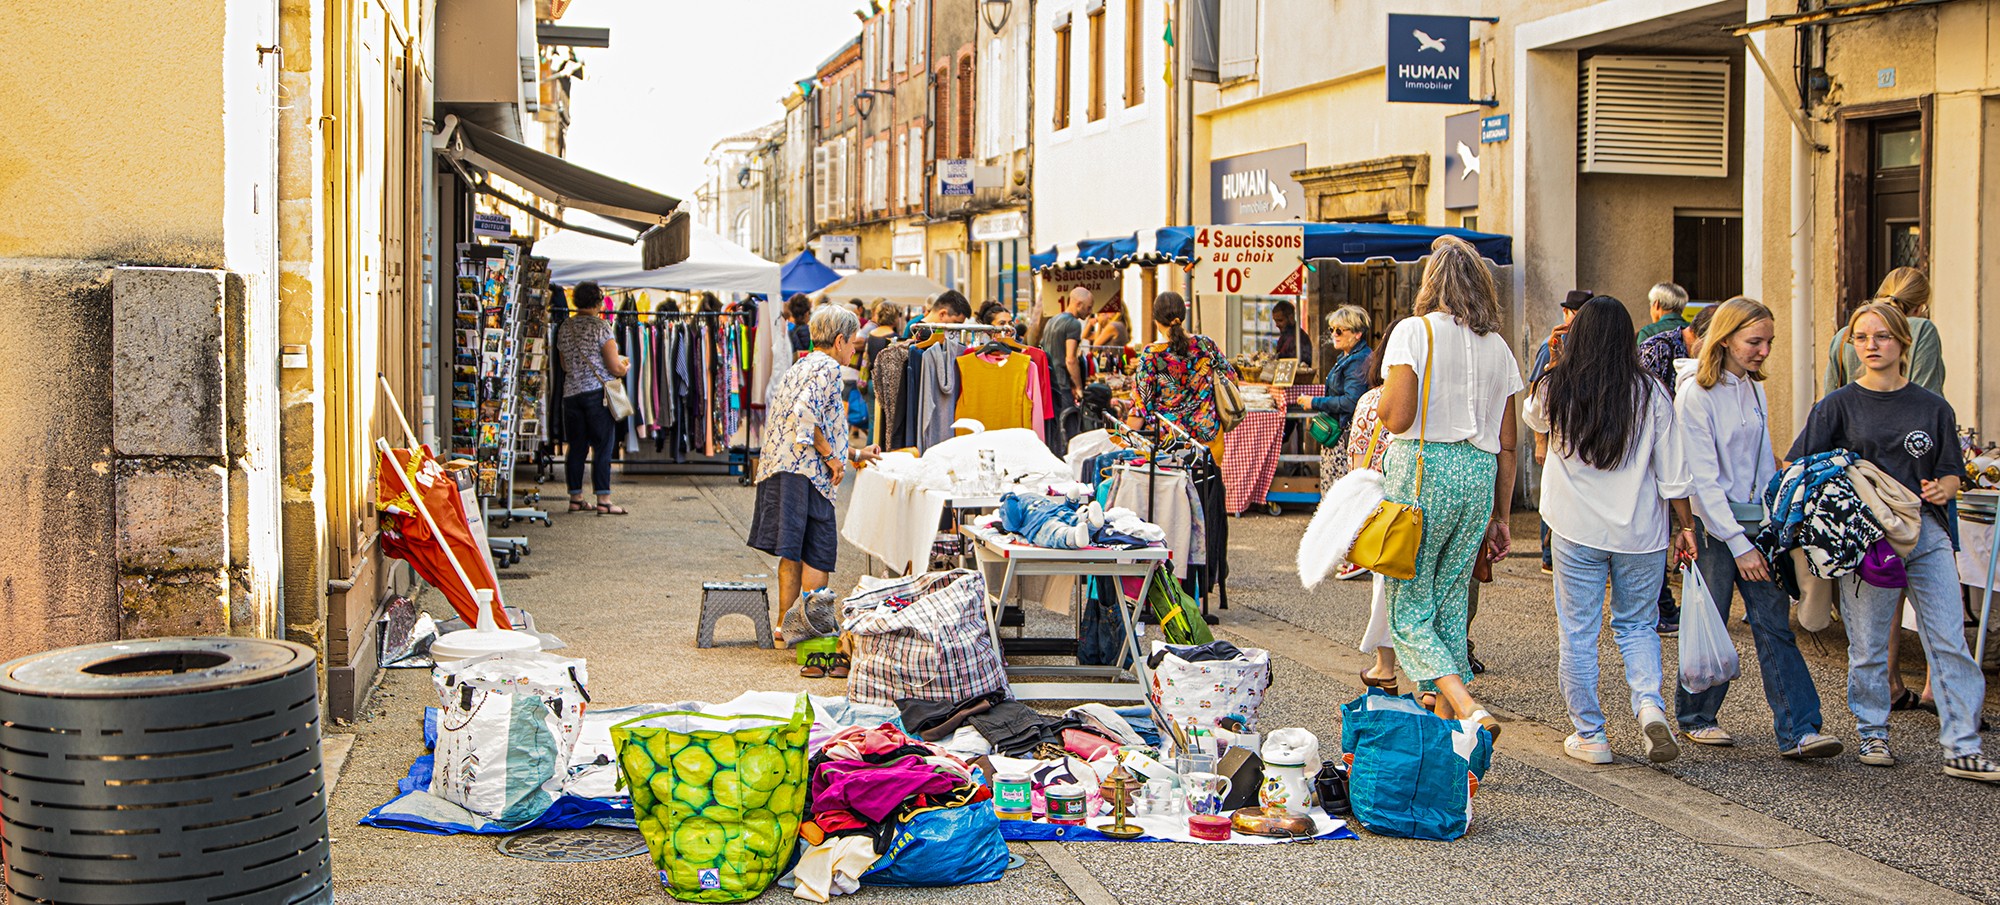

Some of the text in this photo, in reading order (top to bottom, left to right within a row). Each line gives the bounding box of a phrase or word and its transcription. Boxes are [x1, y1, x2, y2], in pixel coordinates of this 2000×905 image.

[1399, 64, 1460, 80] HUMAN
[1405, 81, 1453, 90] Immobilier
[1222, 169, 1267, 200] HUMAN
[480, 214, 506, 222] DIAGRAM
[480, 222, 505, 230] EDITEUR
[1197, 228, 1302, 249] 4 Saucissons
[1213, 249, 1274, 263] au choix
[1054, 268, 1115, 281] Saucisson
[1057, 284, 1068, 292] au
